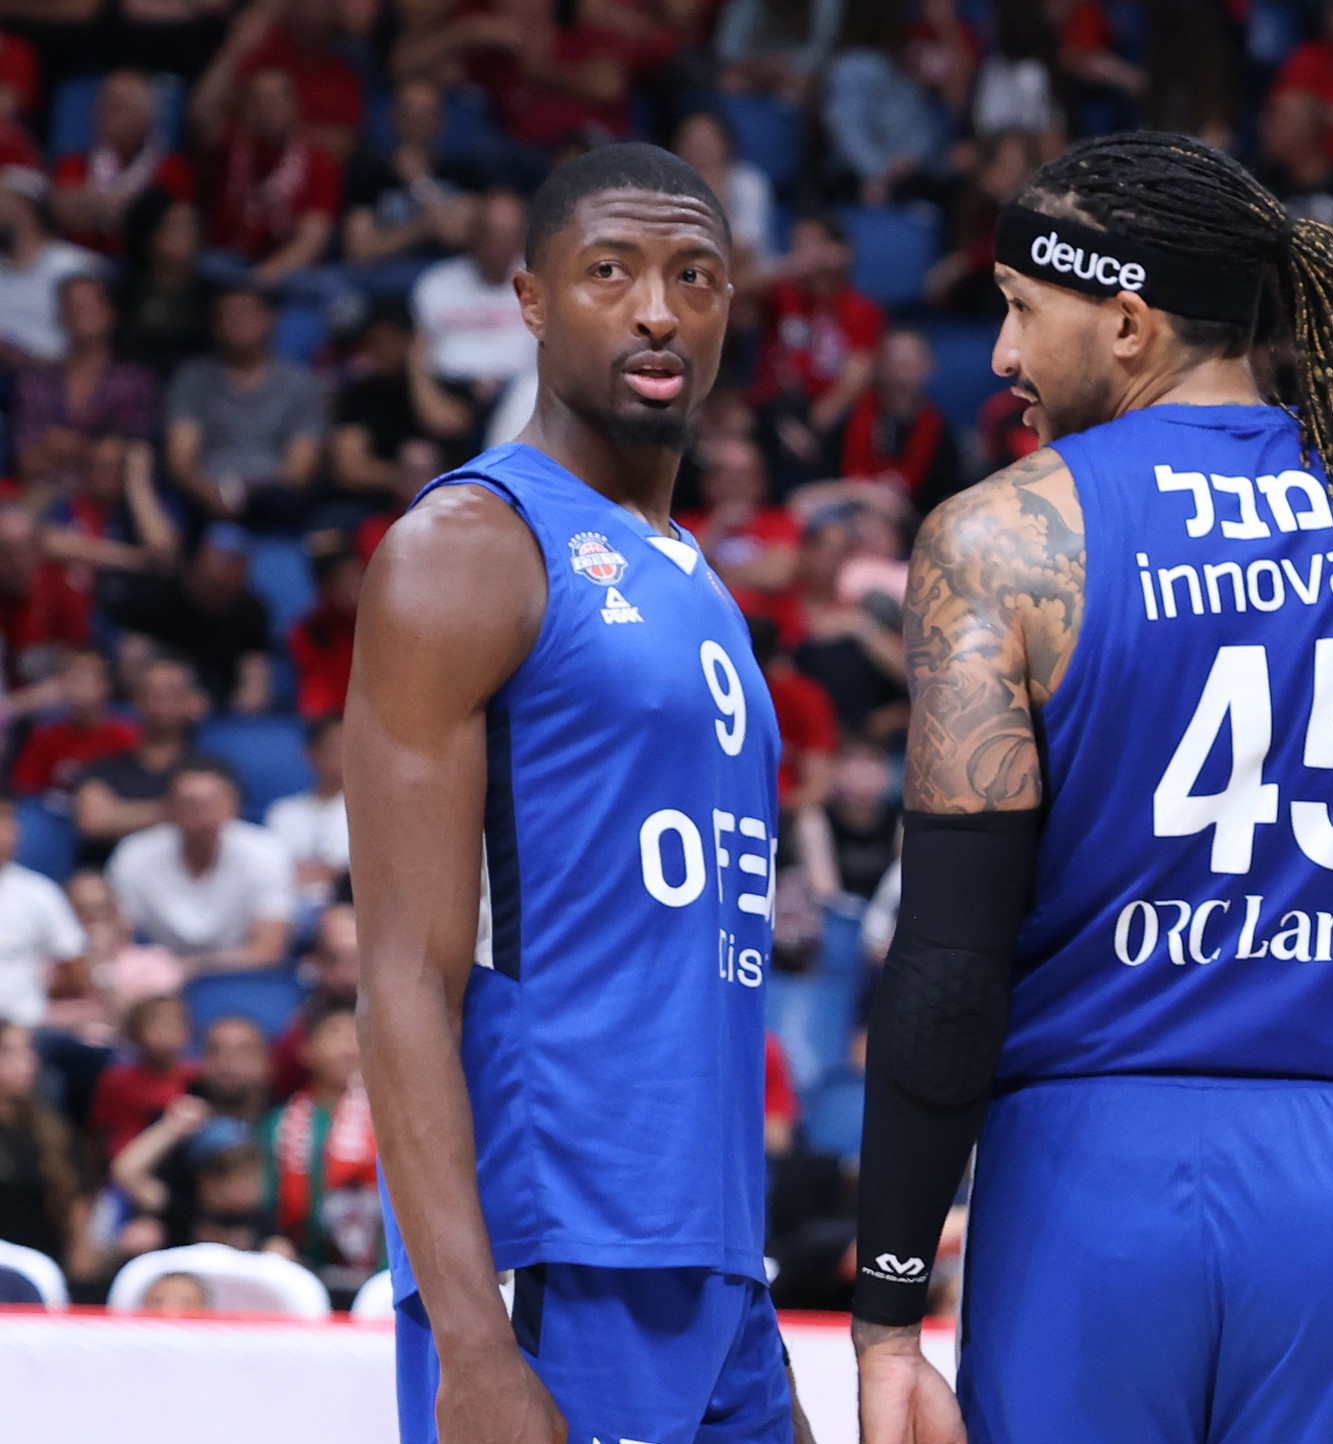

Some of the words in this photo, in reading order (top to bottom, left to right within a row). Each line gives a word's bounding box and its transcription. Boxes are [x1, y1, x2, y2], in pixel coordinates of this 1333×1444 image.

[1031, 231, 1147, 291] deuce
[699, 639, 747, 757] 9
[1114, 899, 1231, 967] ORC
